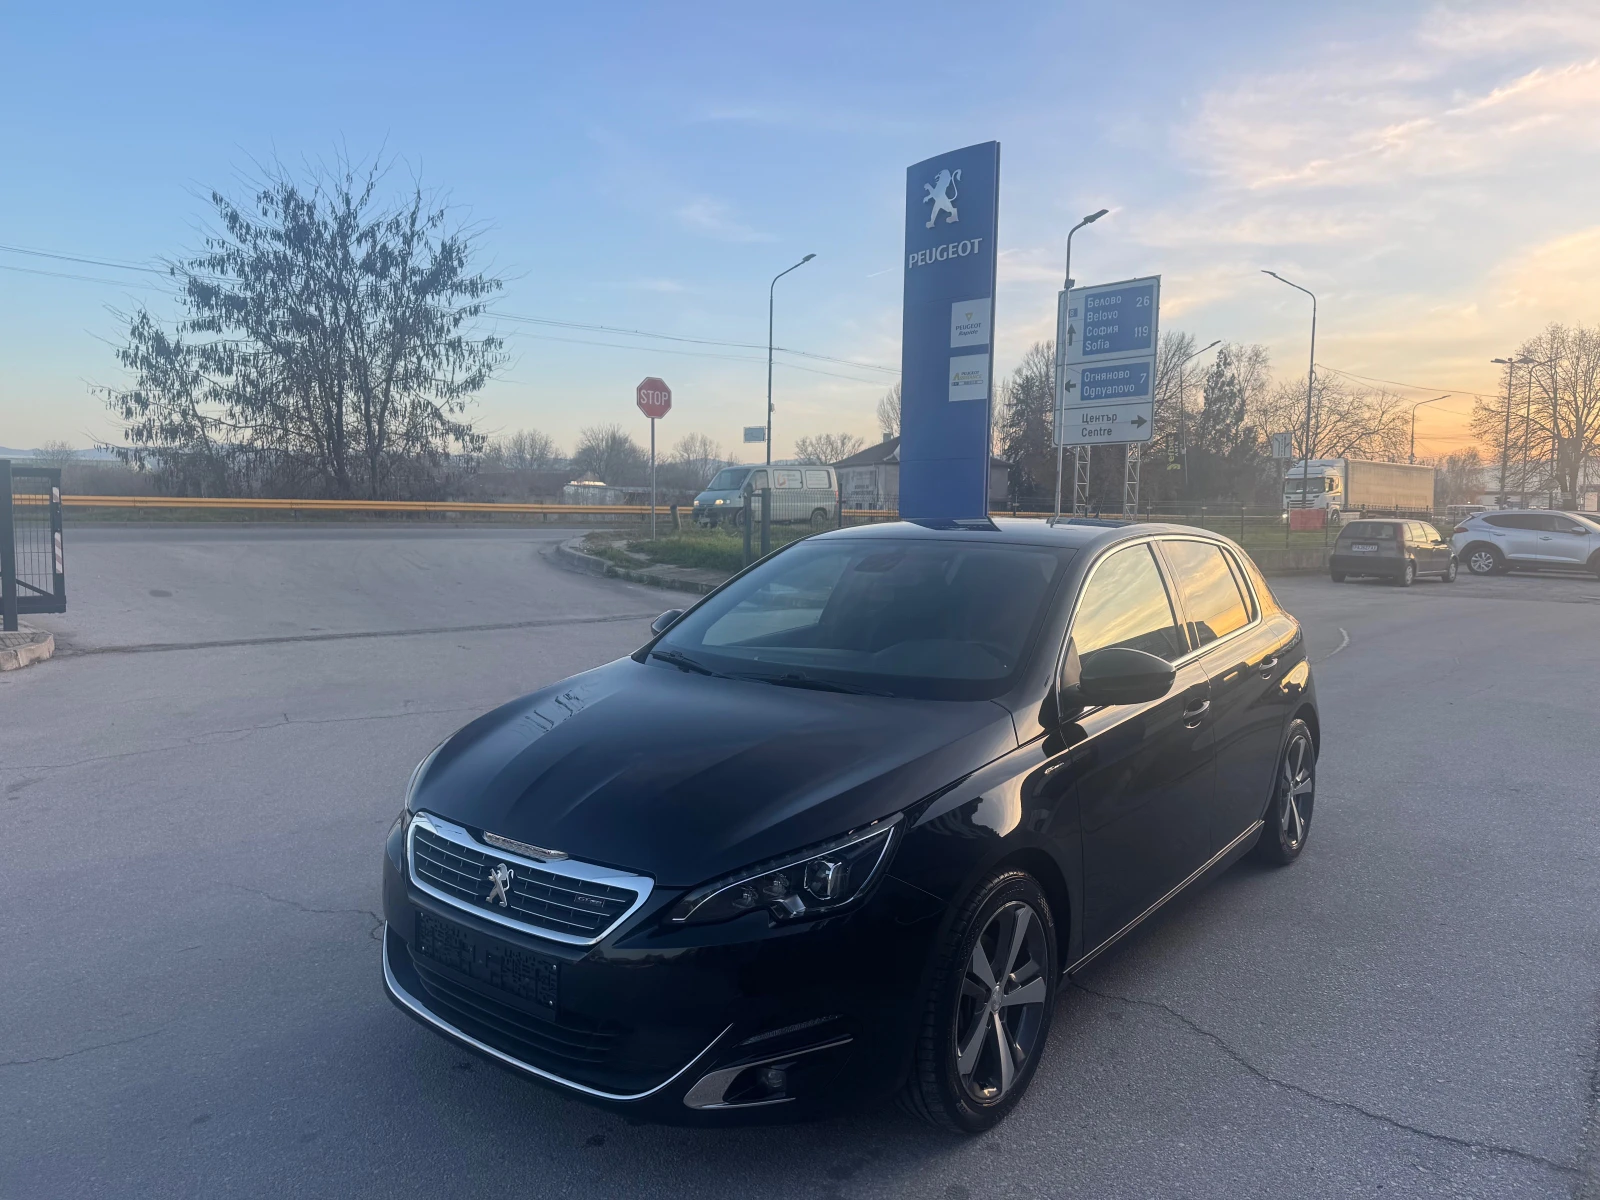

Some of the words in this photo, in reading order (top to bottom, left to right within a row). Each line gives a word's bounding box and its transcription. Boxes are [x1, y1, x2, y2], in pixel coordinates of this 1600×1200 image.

[909, 238, 983, 268] PEUGEOT
[1087, 295, 1122, 308] Белово
[1136, 296, 1150, 307] 26
[1087, 310, 1118, 322] Belovo
[955, 322, 981, 331] PEUGEOT
[1086, 325, 1119, 337] София
[1134, 326, 1149, 337] 119
[1085, 340, 1110, 351] Sofia
[1084, 370, 1130, 382] Огняново
[1140, 373, 1147, 384] 7
[1083, 384, 1135, 398] Ognyanovo
[640, 389, 669, 406] STOP
[1082, 413, 1117, 424] Център
[1081, 427, 1112, 438] Centre
